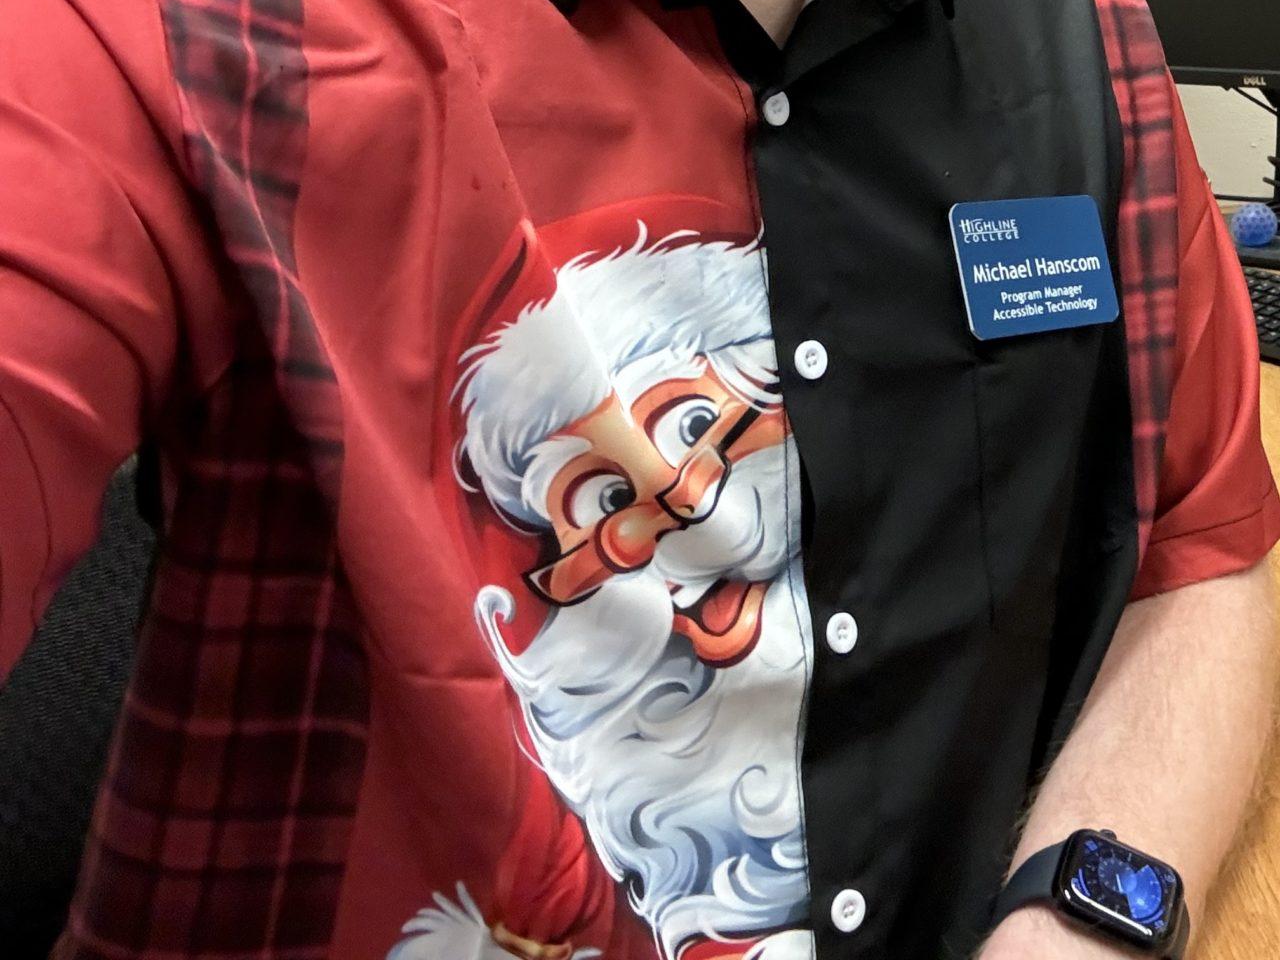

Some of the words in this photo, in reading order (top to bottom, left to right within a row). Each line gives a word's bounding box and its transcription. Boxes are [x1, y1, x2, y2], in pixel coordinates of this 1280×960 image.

[1243, 75, 1267, 86] DELL
[959, 218, 1018, 233] HIGHLINE
[964, 231, 1020, 244] COLLEGE
[973, 258, 1033, 284] Michael
[1035, 255, 1101, 277] Hanscom
[1001, 289, 1042, 305] Program
[1044, 284, 1083, 299] Manager
[993, 304, 1044, 321] Accessible
[1045, 297, 1098, 315] Technology
